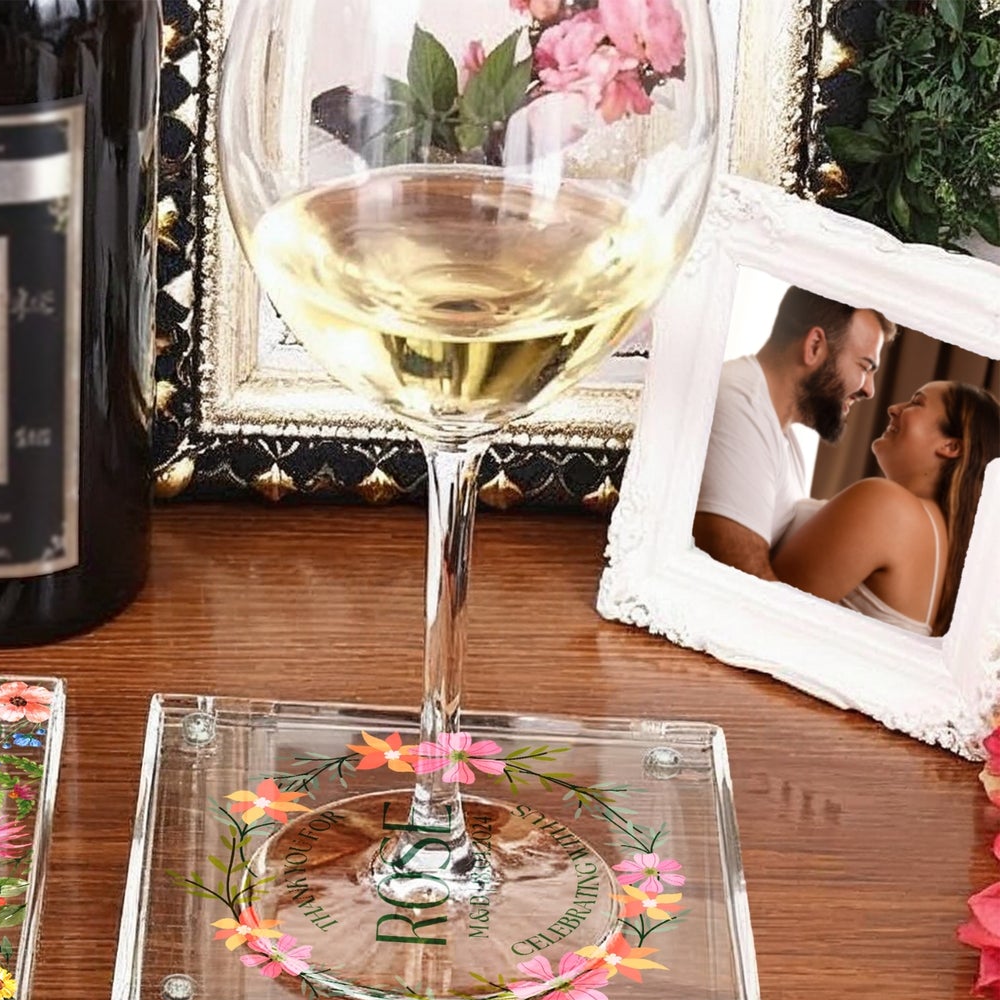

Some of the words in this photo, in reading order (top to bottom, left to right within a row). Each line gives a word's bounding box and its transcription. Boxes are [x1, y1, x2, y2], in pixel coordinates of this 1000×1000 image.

[298, 811, 345, 841] FOR
[510, 805, 545, 825] US
[284, 840, 312, 875] YOU
[376, 802, 452, 945] ROSE
[285, 877, 338, 932] THANK
[511, 862, 599, 956] CELEBRATING
